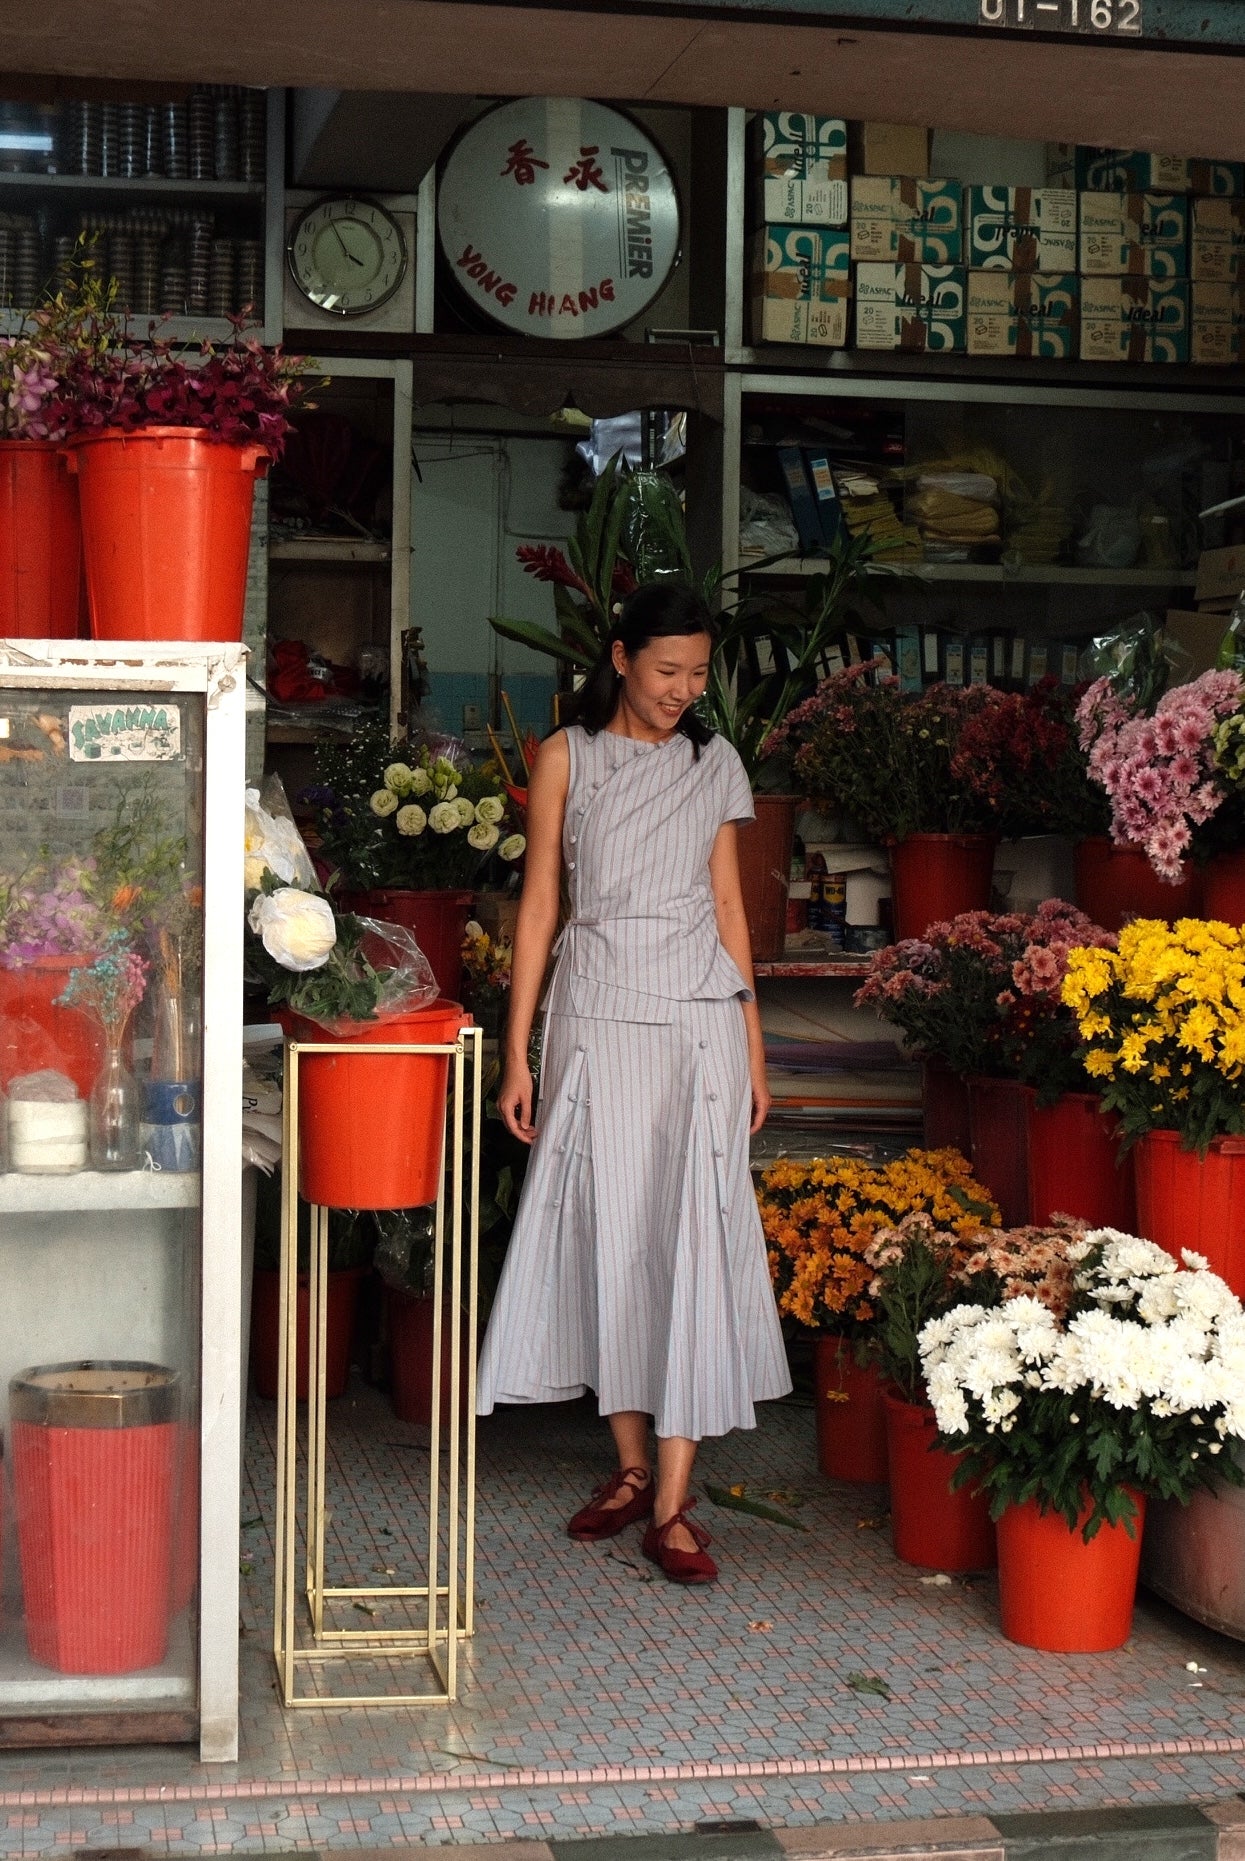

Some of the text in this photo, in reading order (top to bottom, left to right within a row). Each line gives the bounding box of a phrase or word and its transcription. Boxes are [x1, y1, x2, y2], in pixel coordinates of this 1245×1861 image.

[981, 0, 1140, 30] 01-162
[324, 206, 332, 218] 11
[345, 203, 356, 215] 12
[806, 203, 813, 214] 20
[299, 244, 307, 256] 9
[457, 245, 616, 316] YONG HIANG
[870, 287, 893, 296] ASPAC
[864, 307, 874, 315] 20
